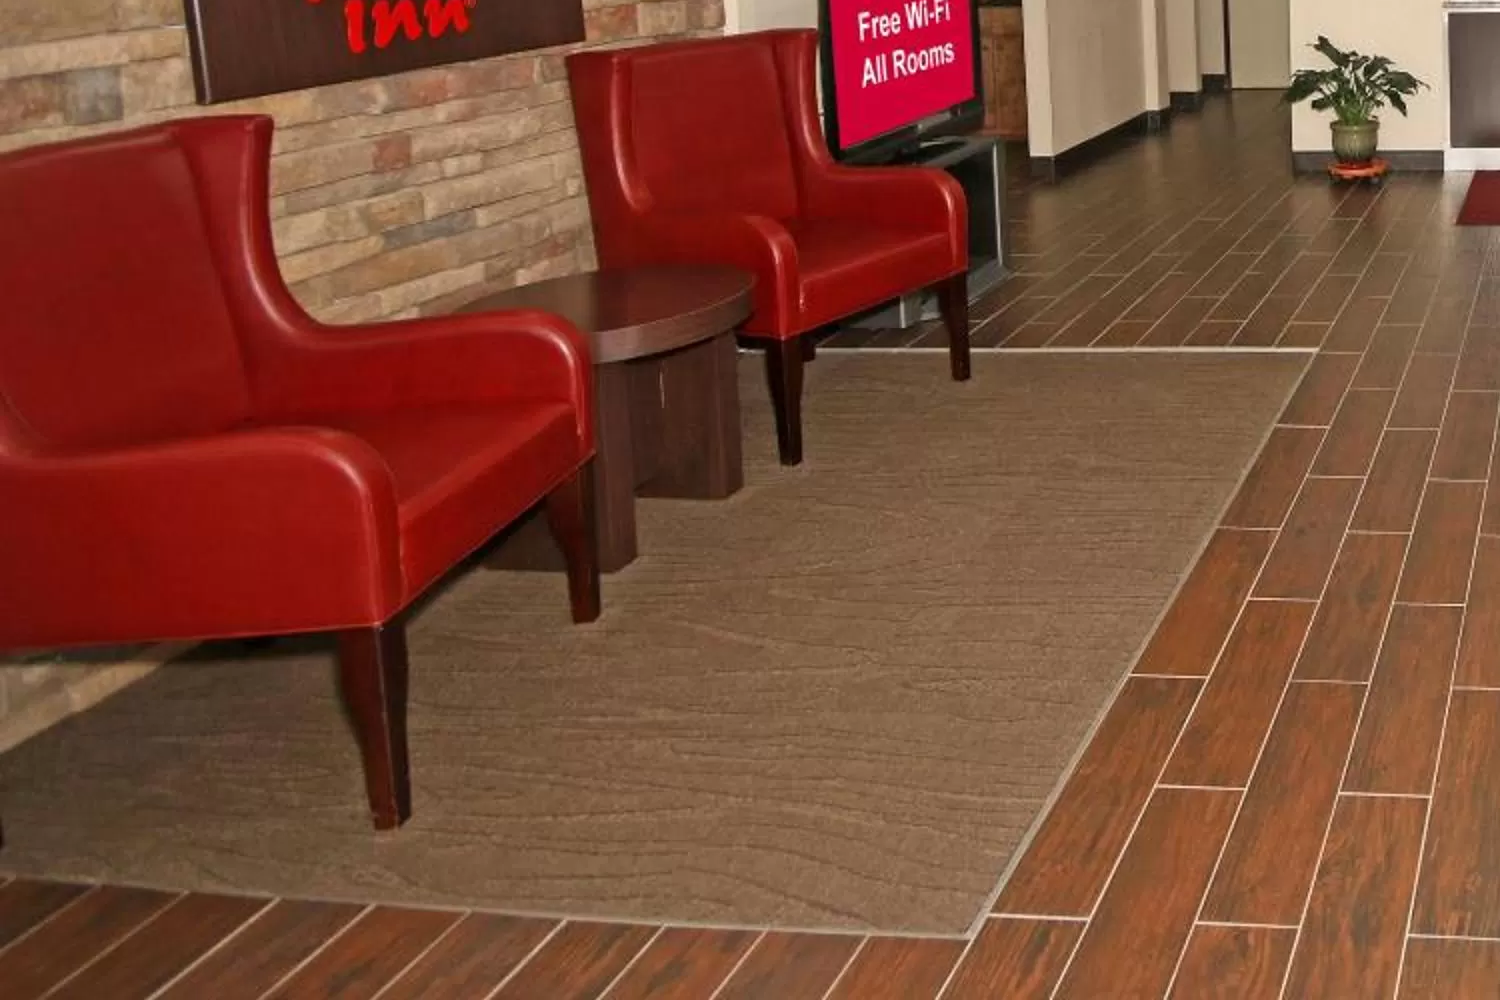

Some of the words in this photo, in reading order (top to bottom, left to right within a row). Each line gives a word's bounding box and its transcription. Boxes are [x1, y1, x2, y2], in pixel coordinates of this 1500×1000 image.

[857, 11, 901, 42] Free
[861, 53, 888, 89] All
[891, 42, 955, 79] Rooms
